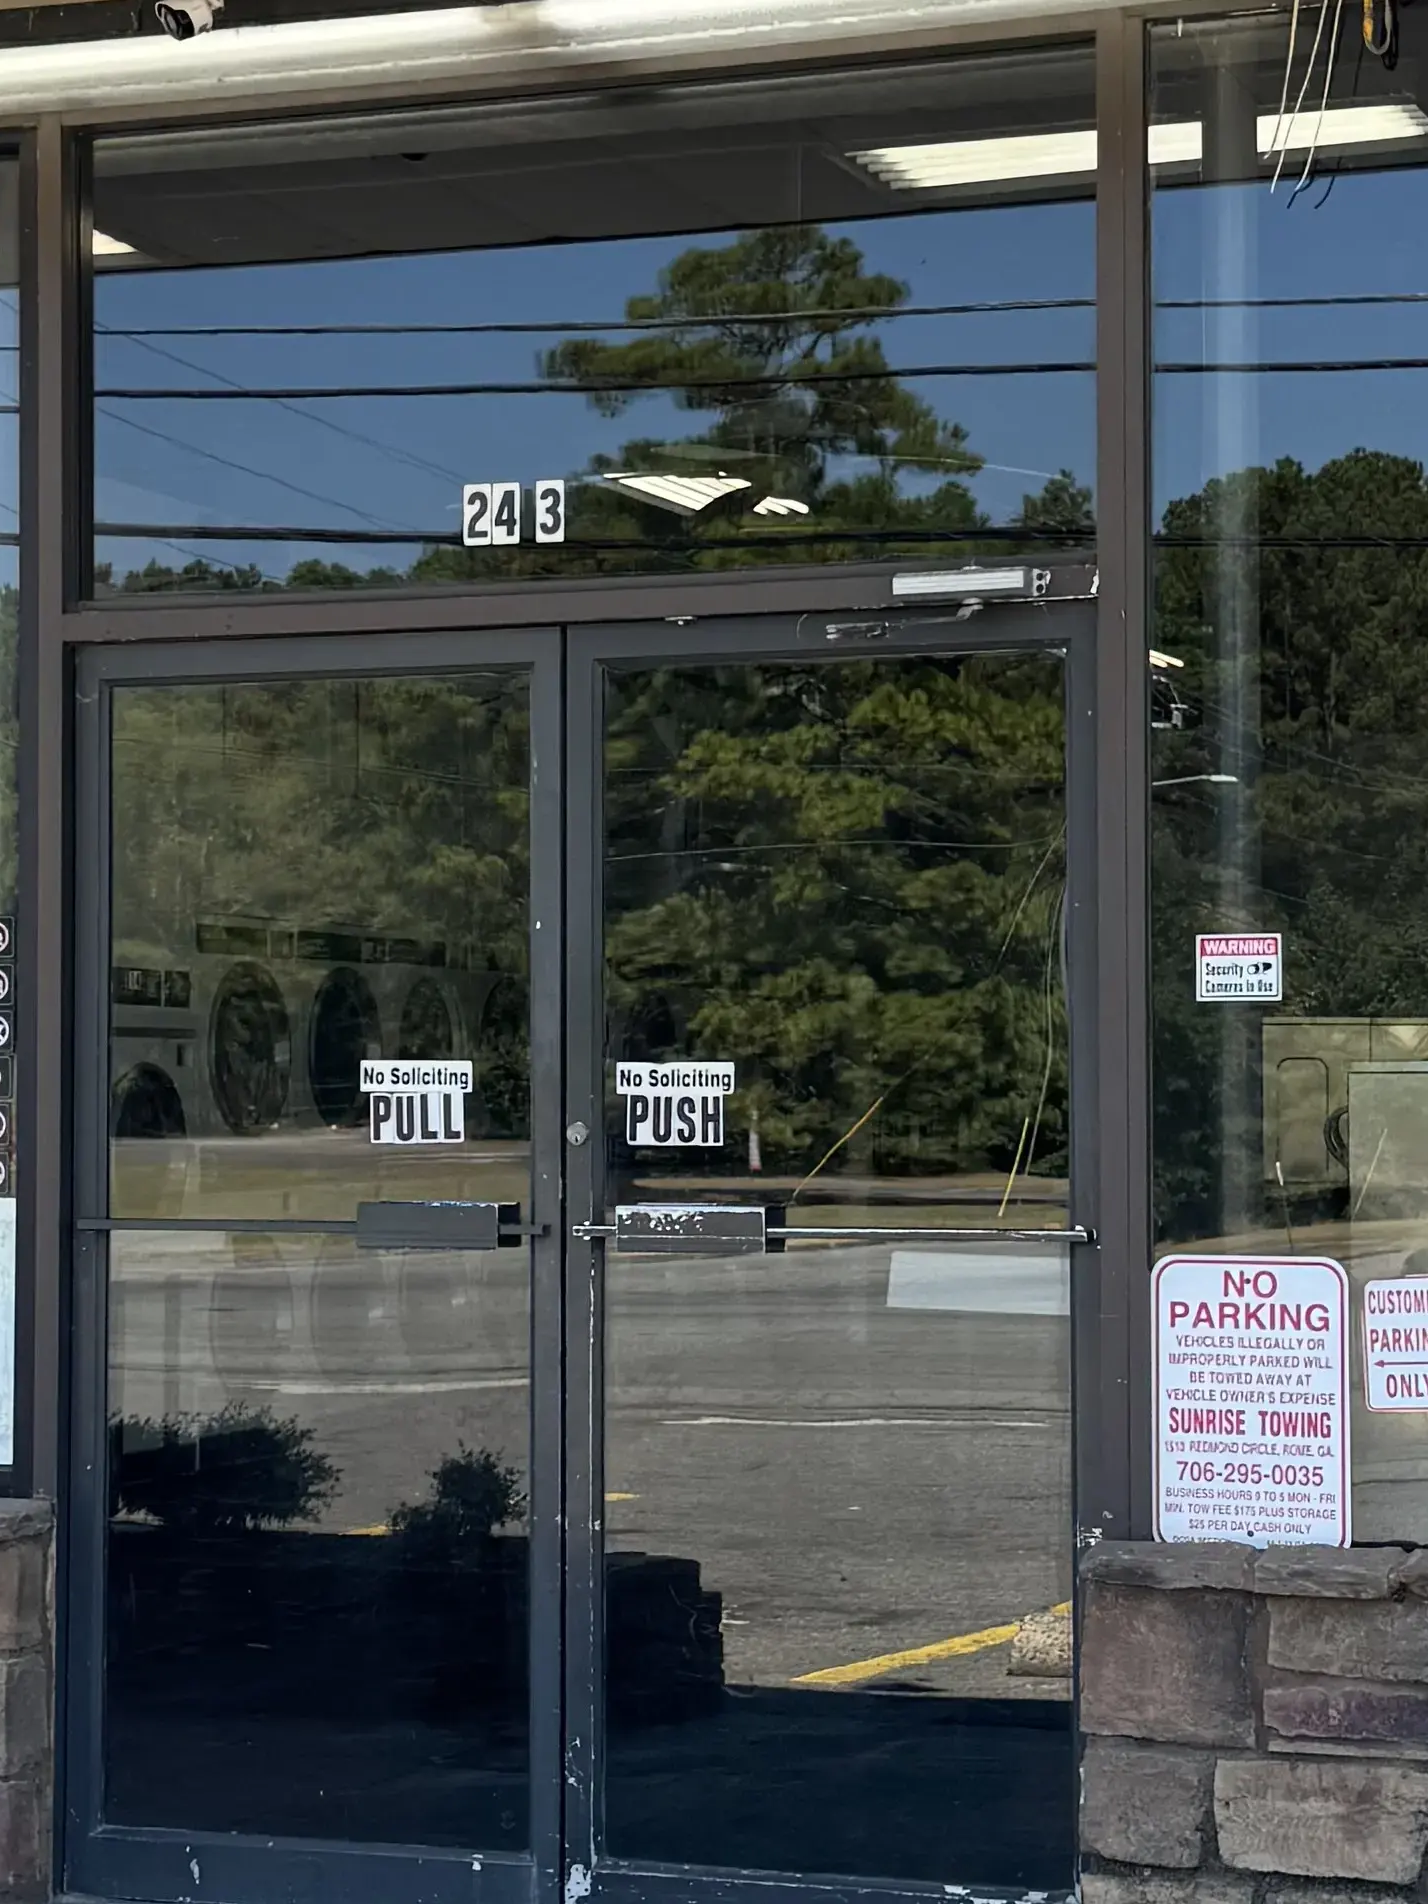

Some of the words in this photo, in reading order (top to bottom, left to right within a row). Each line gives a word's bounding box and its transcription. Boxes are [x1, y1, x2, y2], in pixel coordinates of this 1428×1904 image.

[467, 487, 562, 539] 243
[1203, 939, 1277, 955] WARNING
[1205, 962, 1243, 978] Security
[1205, 980, 1243, 993] Cameras
[363, 1067, 386, 1086] No
[390, 1066, 470, 1091] Soliciting
[620, 1068, 644, 1088] No
[649, 1068, 732, 1092] Soliciting
[373, 1095, 462, 1141] PULL
[629, 1094, 722, 1144] PUSH
[1223, 1270, 1278, 1299] NO
[1169, 1301, 1331, 1333] PARKING
[1176, 1335, 1234, 1348] VEHICLES
[1238, 1336, 1304, 1351] ILLEGALLY
[1307, 1338, 1325, 1351] OR
[1169, 1353, 1247, 1367] IMPROPERLY
[1249, 1354, 1300, 1368] PARKED
[1303, 1356, 1333, 1369] WILL
[1190, 1371, 1205, 1384] BE
[1210, 1371, 1253, 1385] TOWED
[1256, 1373, 1293, 1386] AWAY
[1296, 1374, 1312, 1387] AT
[1166, 1388, 1216, 1402] VEHICLE
[1279, 1391, 1336, 1406] EXPENSE
[1169, 1407, 1246, 1436] SUNRISE
[1258, 1410, 1332, 1438] TOWING
[1176, 1461, 1324, 1487] 706-295-0035
[1166, 1486, 1215, 1499] BUSINESS
[1217, 1489, 1253, 1502] HOURS
[1263, 1491, 1277, 1502] TO
[1287, 1492, 1311, 1504] MON
[1319, 1494, 1336, 1505] FRI
[1187, 1503, 1211, 1515] TOW
[1213, 1504, 1232, 1516] FEE
[1259, 1506, 1285, 1519] PLUS
[1287, 1507, 1336, 1521] STORAGE
[1208, 1520, 1228, 1532] PER
[1253, 1522, 1282, 1534] CASH
[1284, 1523, 1312, 1535] ONLY
